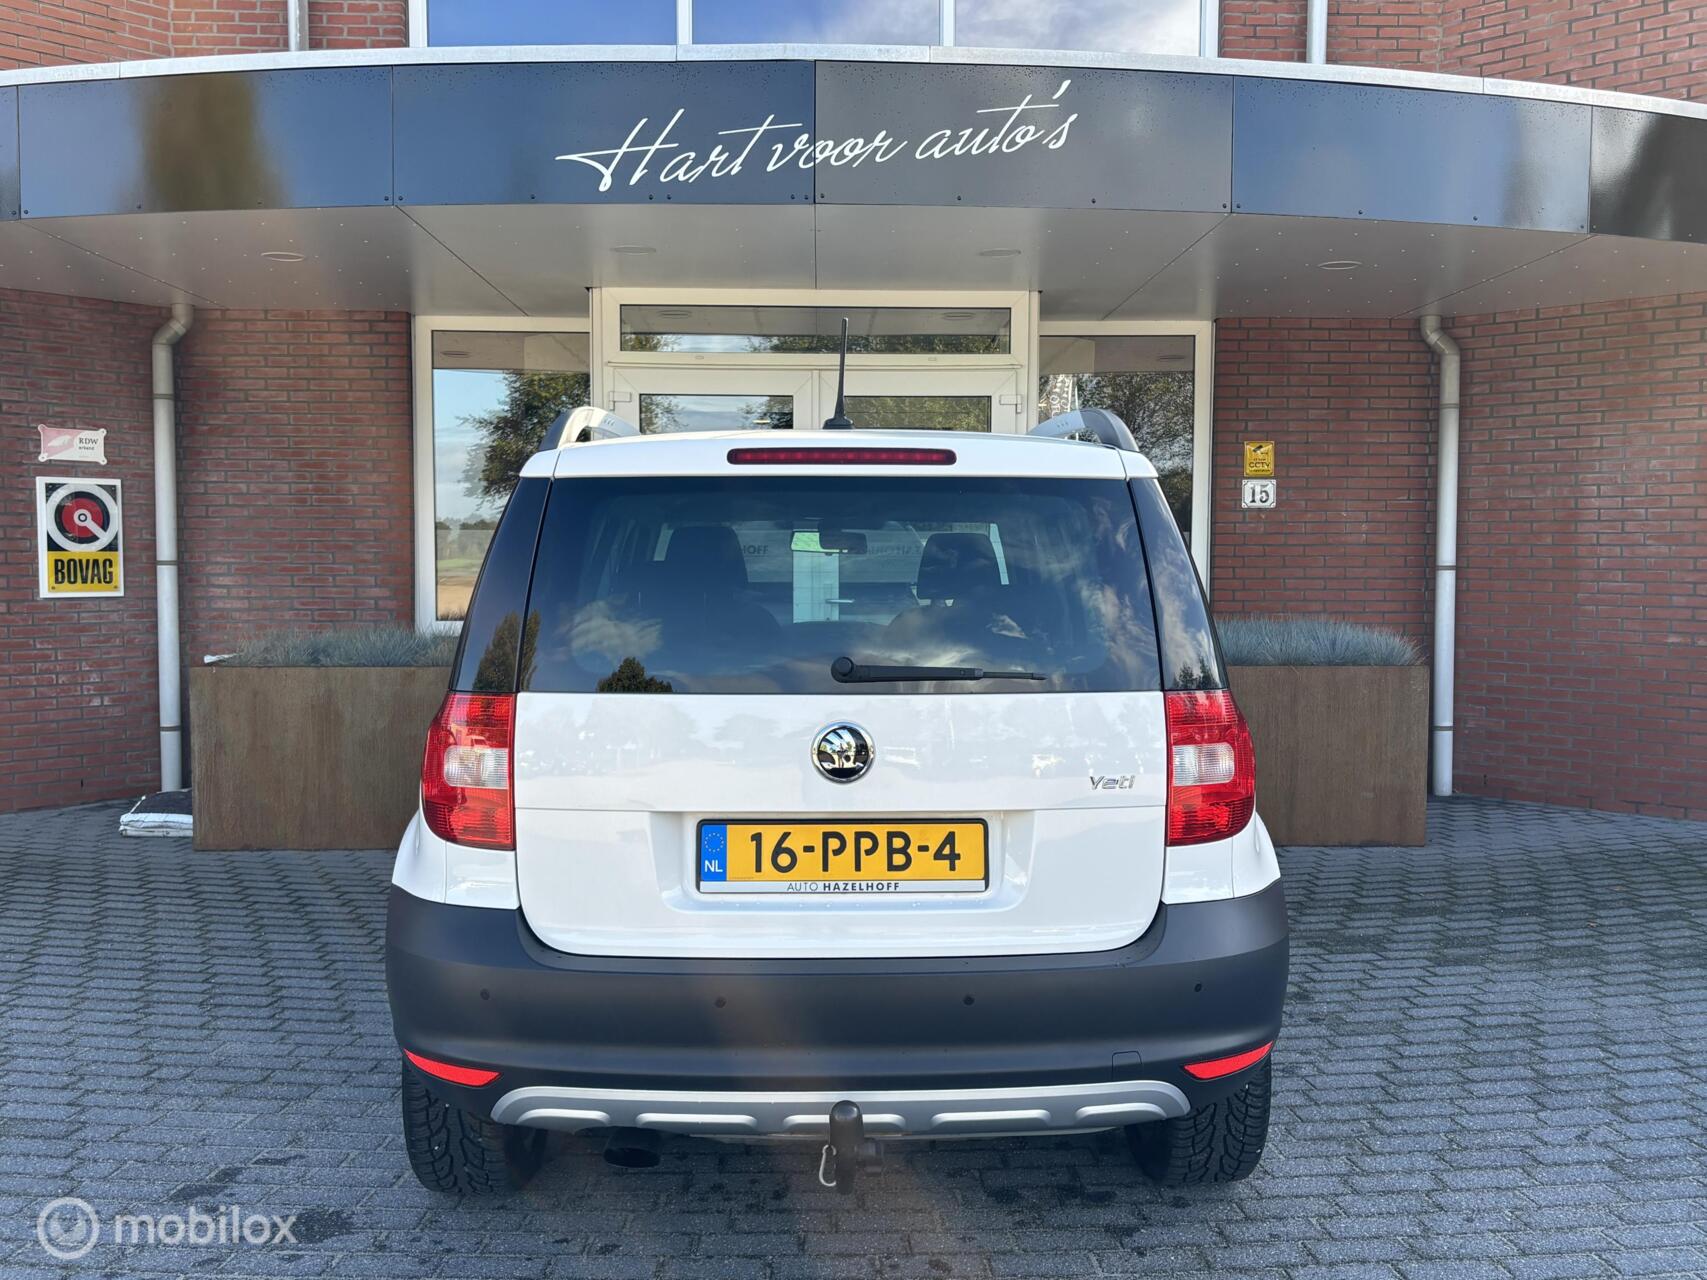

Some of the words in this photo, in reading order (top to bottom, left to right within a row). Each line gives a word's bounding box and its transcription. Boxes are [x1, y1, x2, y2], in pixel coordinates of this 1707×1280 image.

[555, 108, 803, 192] Hart
[770, 128, 907, 170] voor
[915, 79, 1079, 161] auto's
[78, 437, 99, 445] RDW
[1249, 484, 1270, 503] 15
[54, 558, 113, 585] BOVAG
[1089, 774, 1136, 790] Yeti
[750, 830, 961, 873] 16-PPB-4
[704, 859, 723, 873] NL
[787, 882, 819, 892] AUTO
[822, 881, 900, 892] HAZELHOFF
